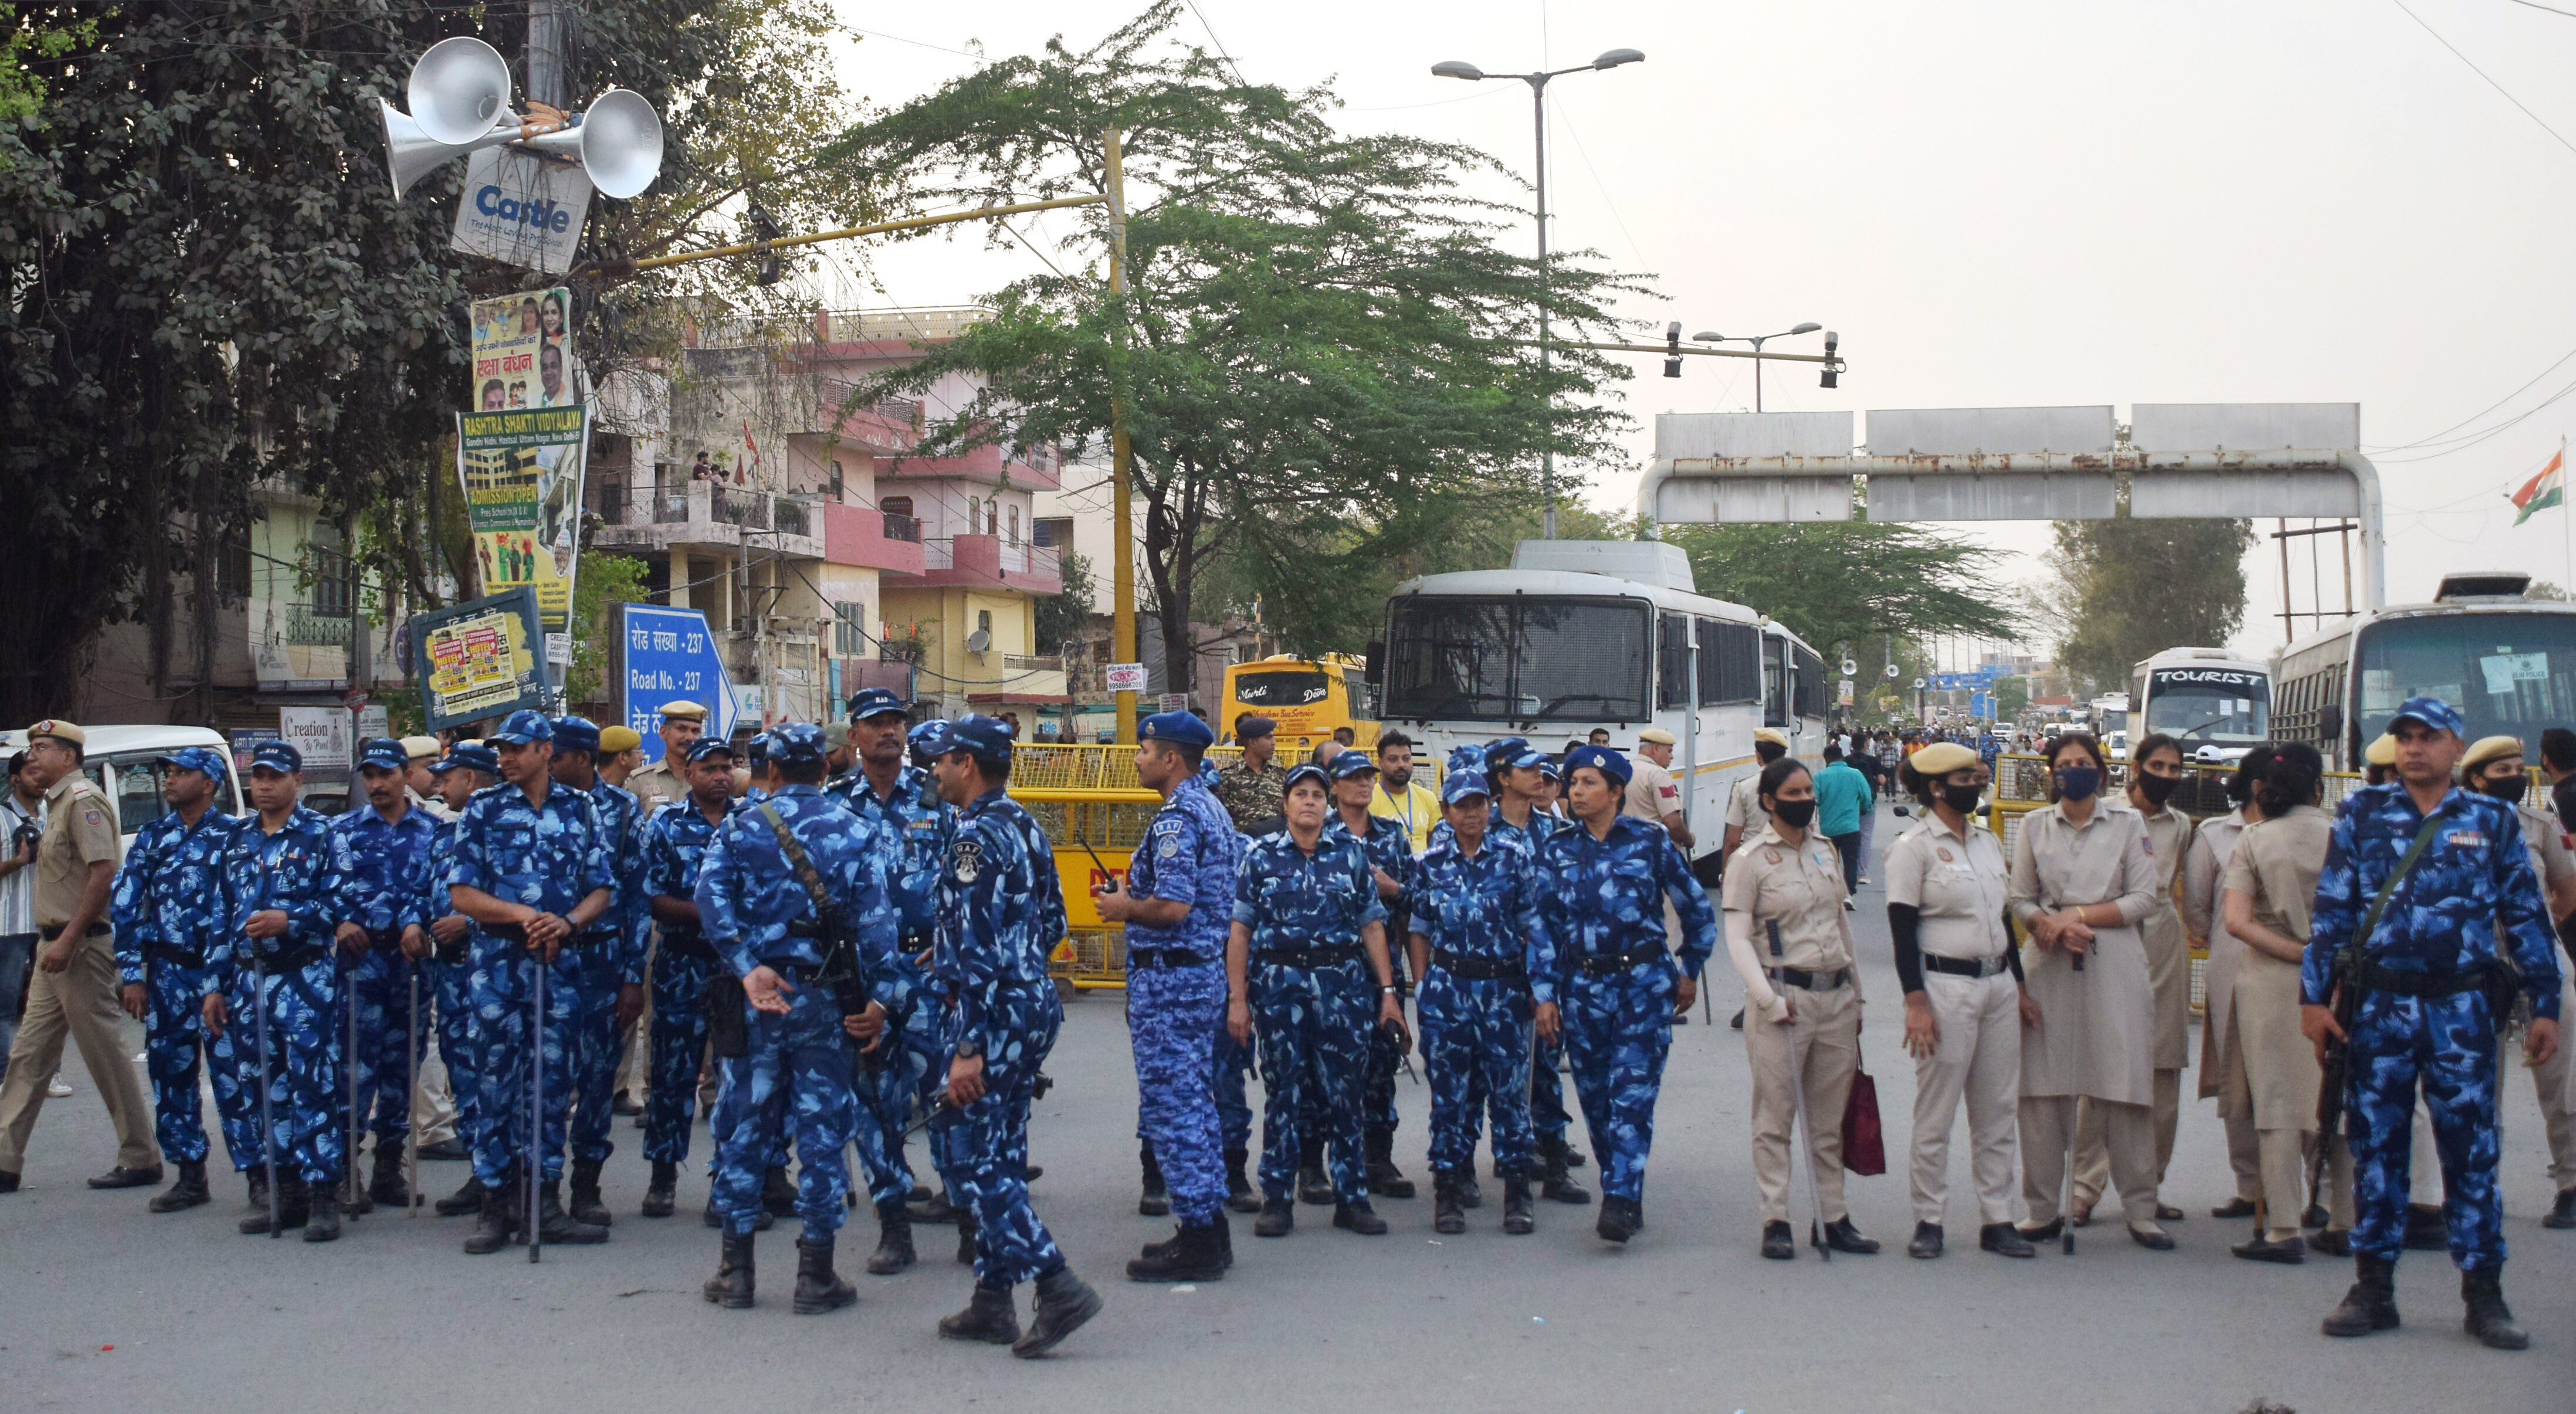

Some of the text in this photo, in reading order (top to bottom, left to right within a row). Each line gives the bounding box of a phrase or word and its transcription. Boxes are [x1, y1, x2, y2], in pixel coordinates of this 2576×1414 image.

[476, 185, 570, 233] Castle
[477, 348, 533, 377] रक्षा बंधन
[465, 411, 581, 436] RASHTRA SHAKTI VIDYALAYA
[472, 486, 537, 504] ADMISSION OPEN
[632, 622, 649, 650] रोड
[653, 623, 677, 652] संख्या
[687, 633, 703, 653] 237
[469, 642, 490, 654] HOTEL
[436, 654, 458, 666] HOTEL
[632, 669, 656, 690] Road
[660, 670, 675, 690] No.
[685, 672, 700, 691] 237
[1109, 681, 1143, 690] 9958666209
[2156, 670, 2262, 686] TOURIST
[1238, 685, 1267, 700] Murli
[1280, 709, 1291, 717] Bus
[1292, 708, 1315, 718] Service
[285, 716, 328, 738] Creation
[235, 737, 247, 748] ARTI
[304, 738, 312, 754] By
[1158, 823, 1179, 832] RAF
[957, 845, 979, 854] RAF
